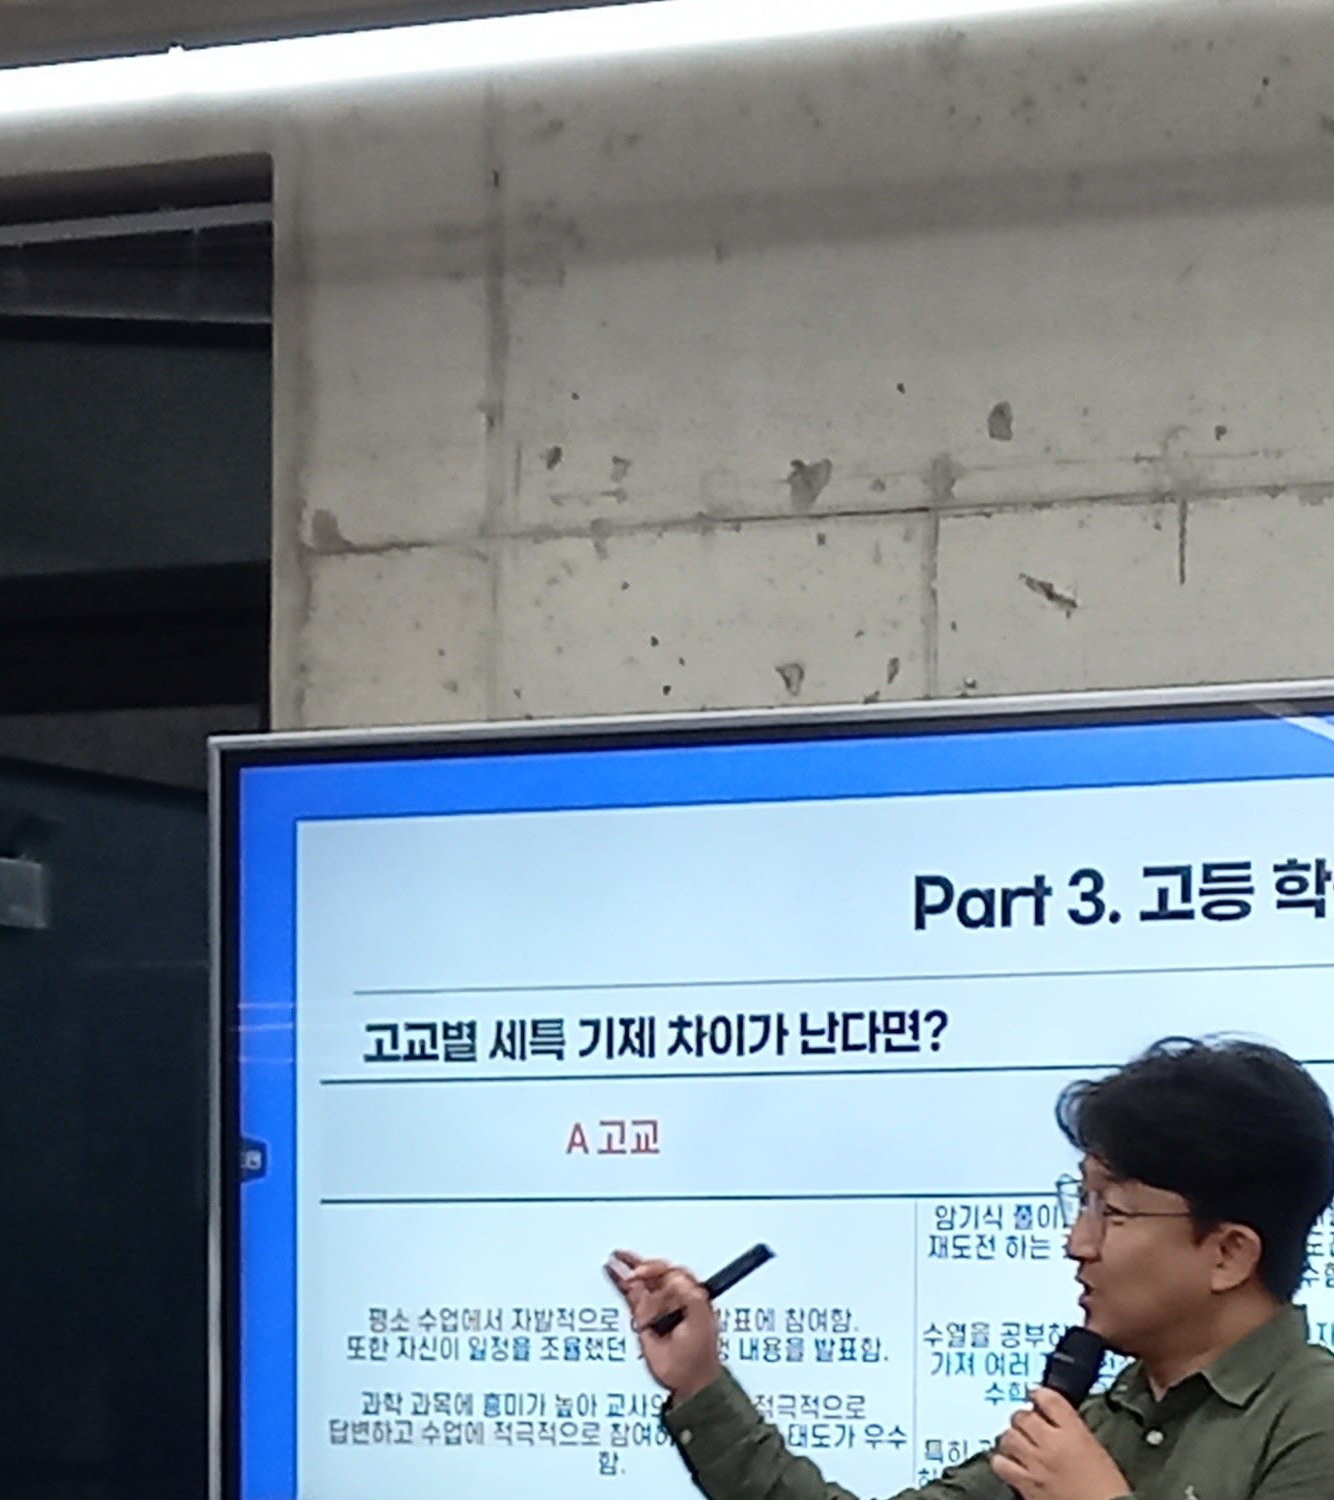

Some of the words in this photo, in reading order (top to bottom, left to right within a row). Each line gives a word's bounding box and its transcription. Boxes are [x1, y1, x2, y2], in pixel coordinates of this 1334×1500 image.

[914, 874, 1053, 930] Part
[1067, 867, 1121, 926] 3.
[1140, 861, 1255, 922] 고등
[364, 1020, 478, 1063] 고교별
[489, 1018, 566, 1061] 세특
[578, 1016, 655, 1059] 기제
[667, 1012, 789, 1057] 차이가
[799, 1009, 948, 1055] 난다면?
[566, 1122, 589, 1154] A
[597, 1119, 660, 1154] 고교
[935, 1203, 1003, 1231] 암기식
[928, 1233, 995, 1260] 재도전
[1005, 1234, 1051, 1260] 하는
[368, 1307, 410, 1333] 평소
[418, 1307, 503, 1333] 수업에서
[512, 1307, 621, 1333] 자발적으로
[785, 1306, 860, 1334] 참여함.
[923, 1322, 990, 1348] 수열을
[347, 1336, 389, 1361] 또한
[398, 1336, 460, 1361] 자신이
[469, 1336, 531, 1361] 일정을
[739, 1336, 804, 1363] 내용을
[814, 1336, 889, 1364] 발표함.
[931, 1351, 975, 1377] 가져
[984, 1351, 1029, 1377] 여러
[362, 1391, 403, 1417] 과학
[411, 1391, 474, 1417] 과목에
[482, 1391, 547, 1417] 흥미가
[554, 1391, 598, 1417] 높아
[328, 1419, 414, 1446] 답변하고
[422, 1419, 485, 1446] 수업에
[494, 1420, 602, 1446] 적극적으로
[864, 1423, 908, 1449] 우수
[599, 1450, 626, 1476] 함.
